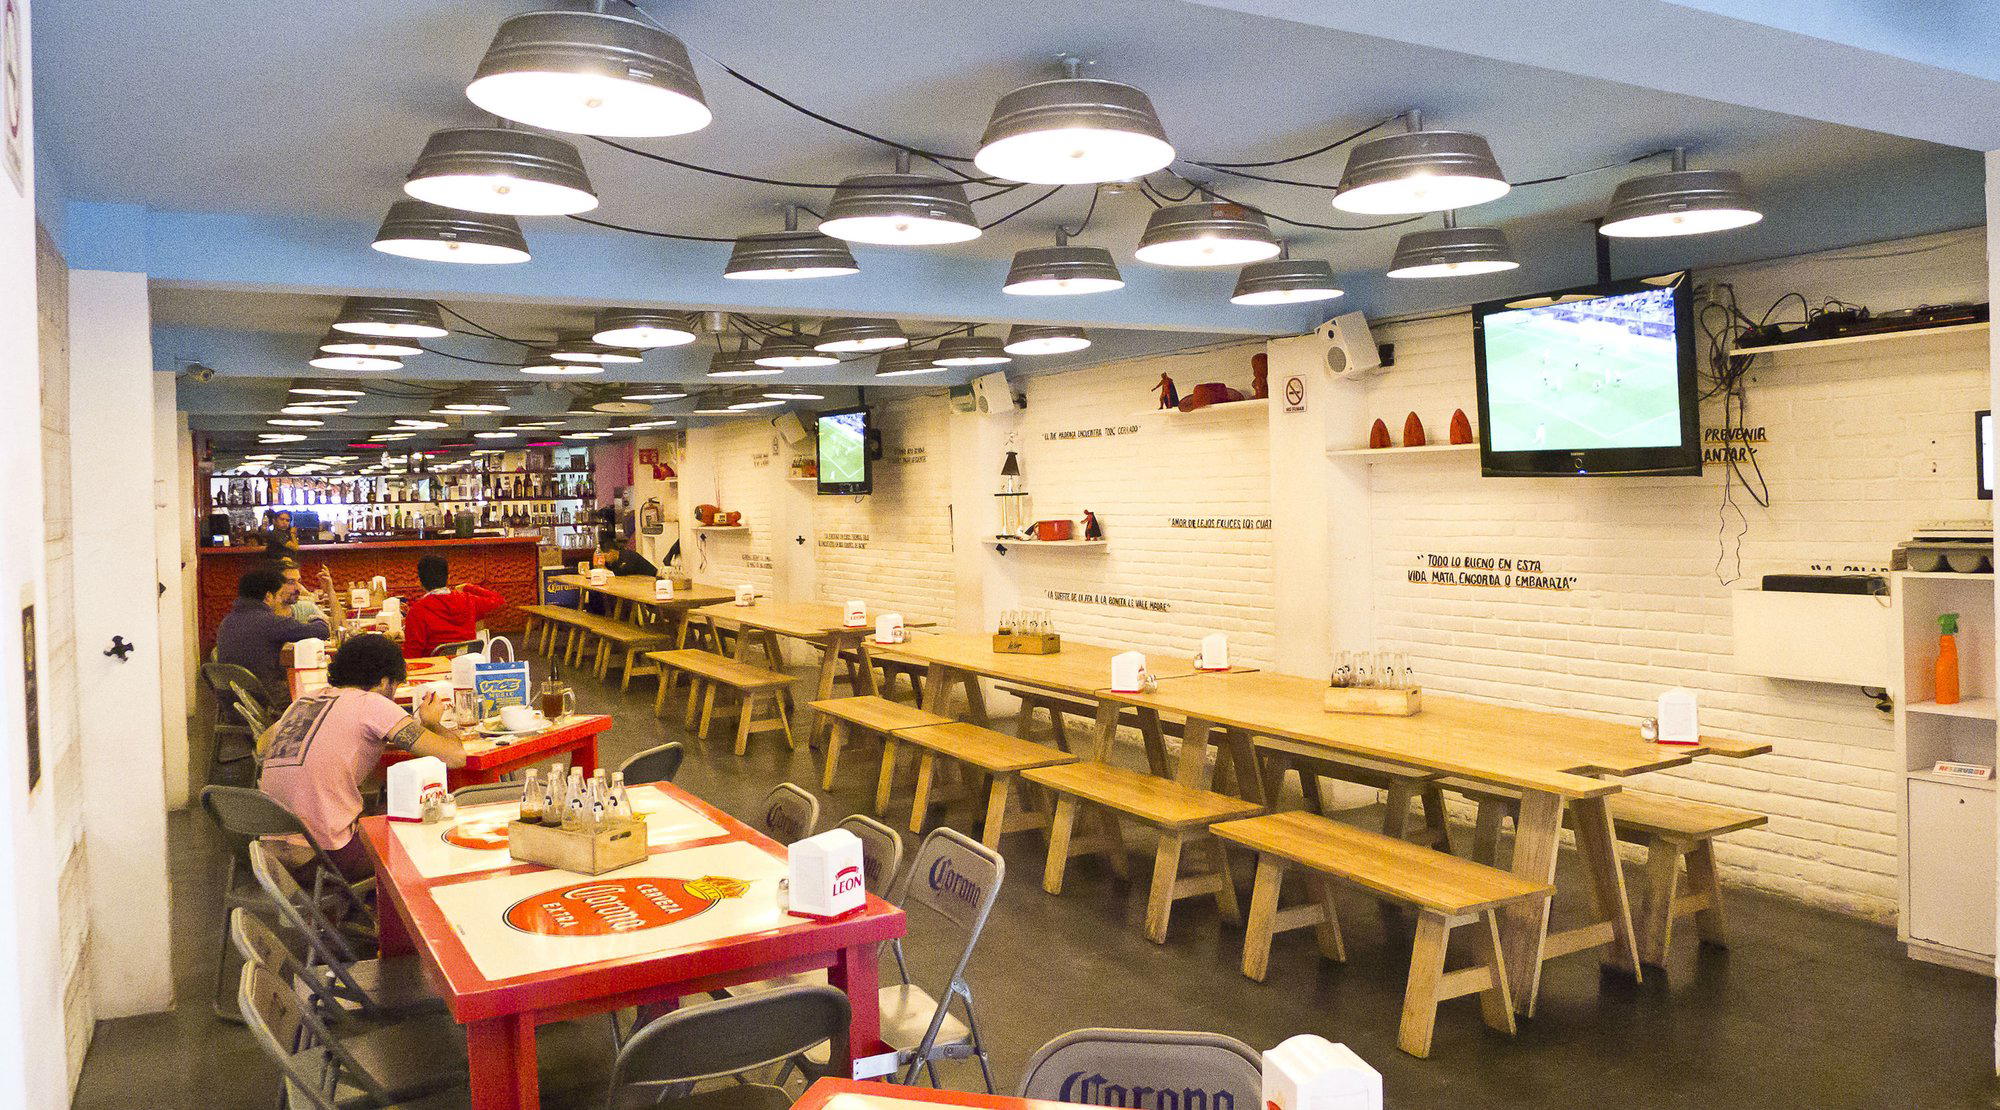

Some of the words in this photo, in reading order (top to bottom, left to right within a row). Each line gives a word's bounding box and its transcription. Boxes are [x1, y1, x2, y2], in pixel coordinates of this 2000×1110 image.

[1451, 556, 1461, 567] LO
[1464, 556, 1495, 569] BUENO
[1498, 558, 1511, 570] EN
[1516, 560, 1542, 571] ESTA
[1408, 570, 1427, 582] VIDA
[1459, 572, 1501, 586] ENGORDA
[1504, 574, 1511, 588] O
[832, 874, 863, 897] LEON
[561, 884, 647, 931] Corona
[636, 883, 684, 914] CERVEZA
[542, 901, 580, 928] EXTRA
